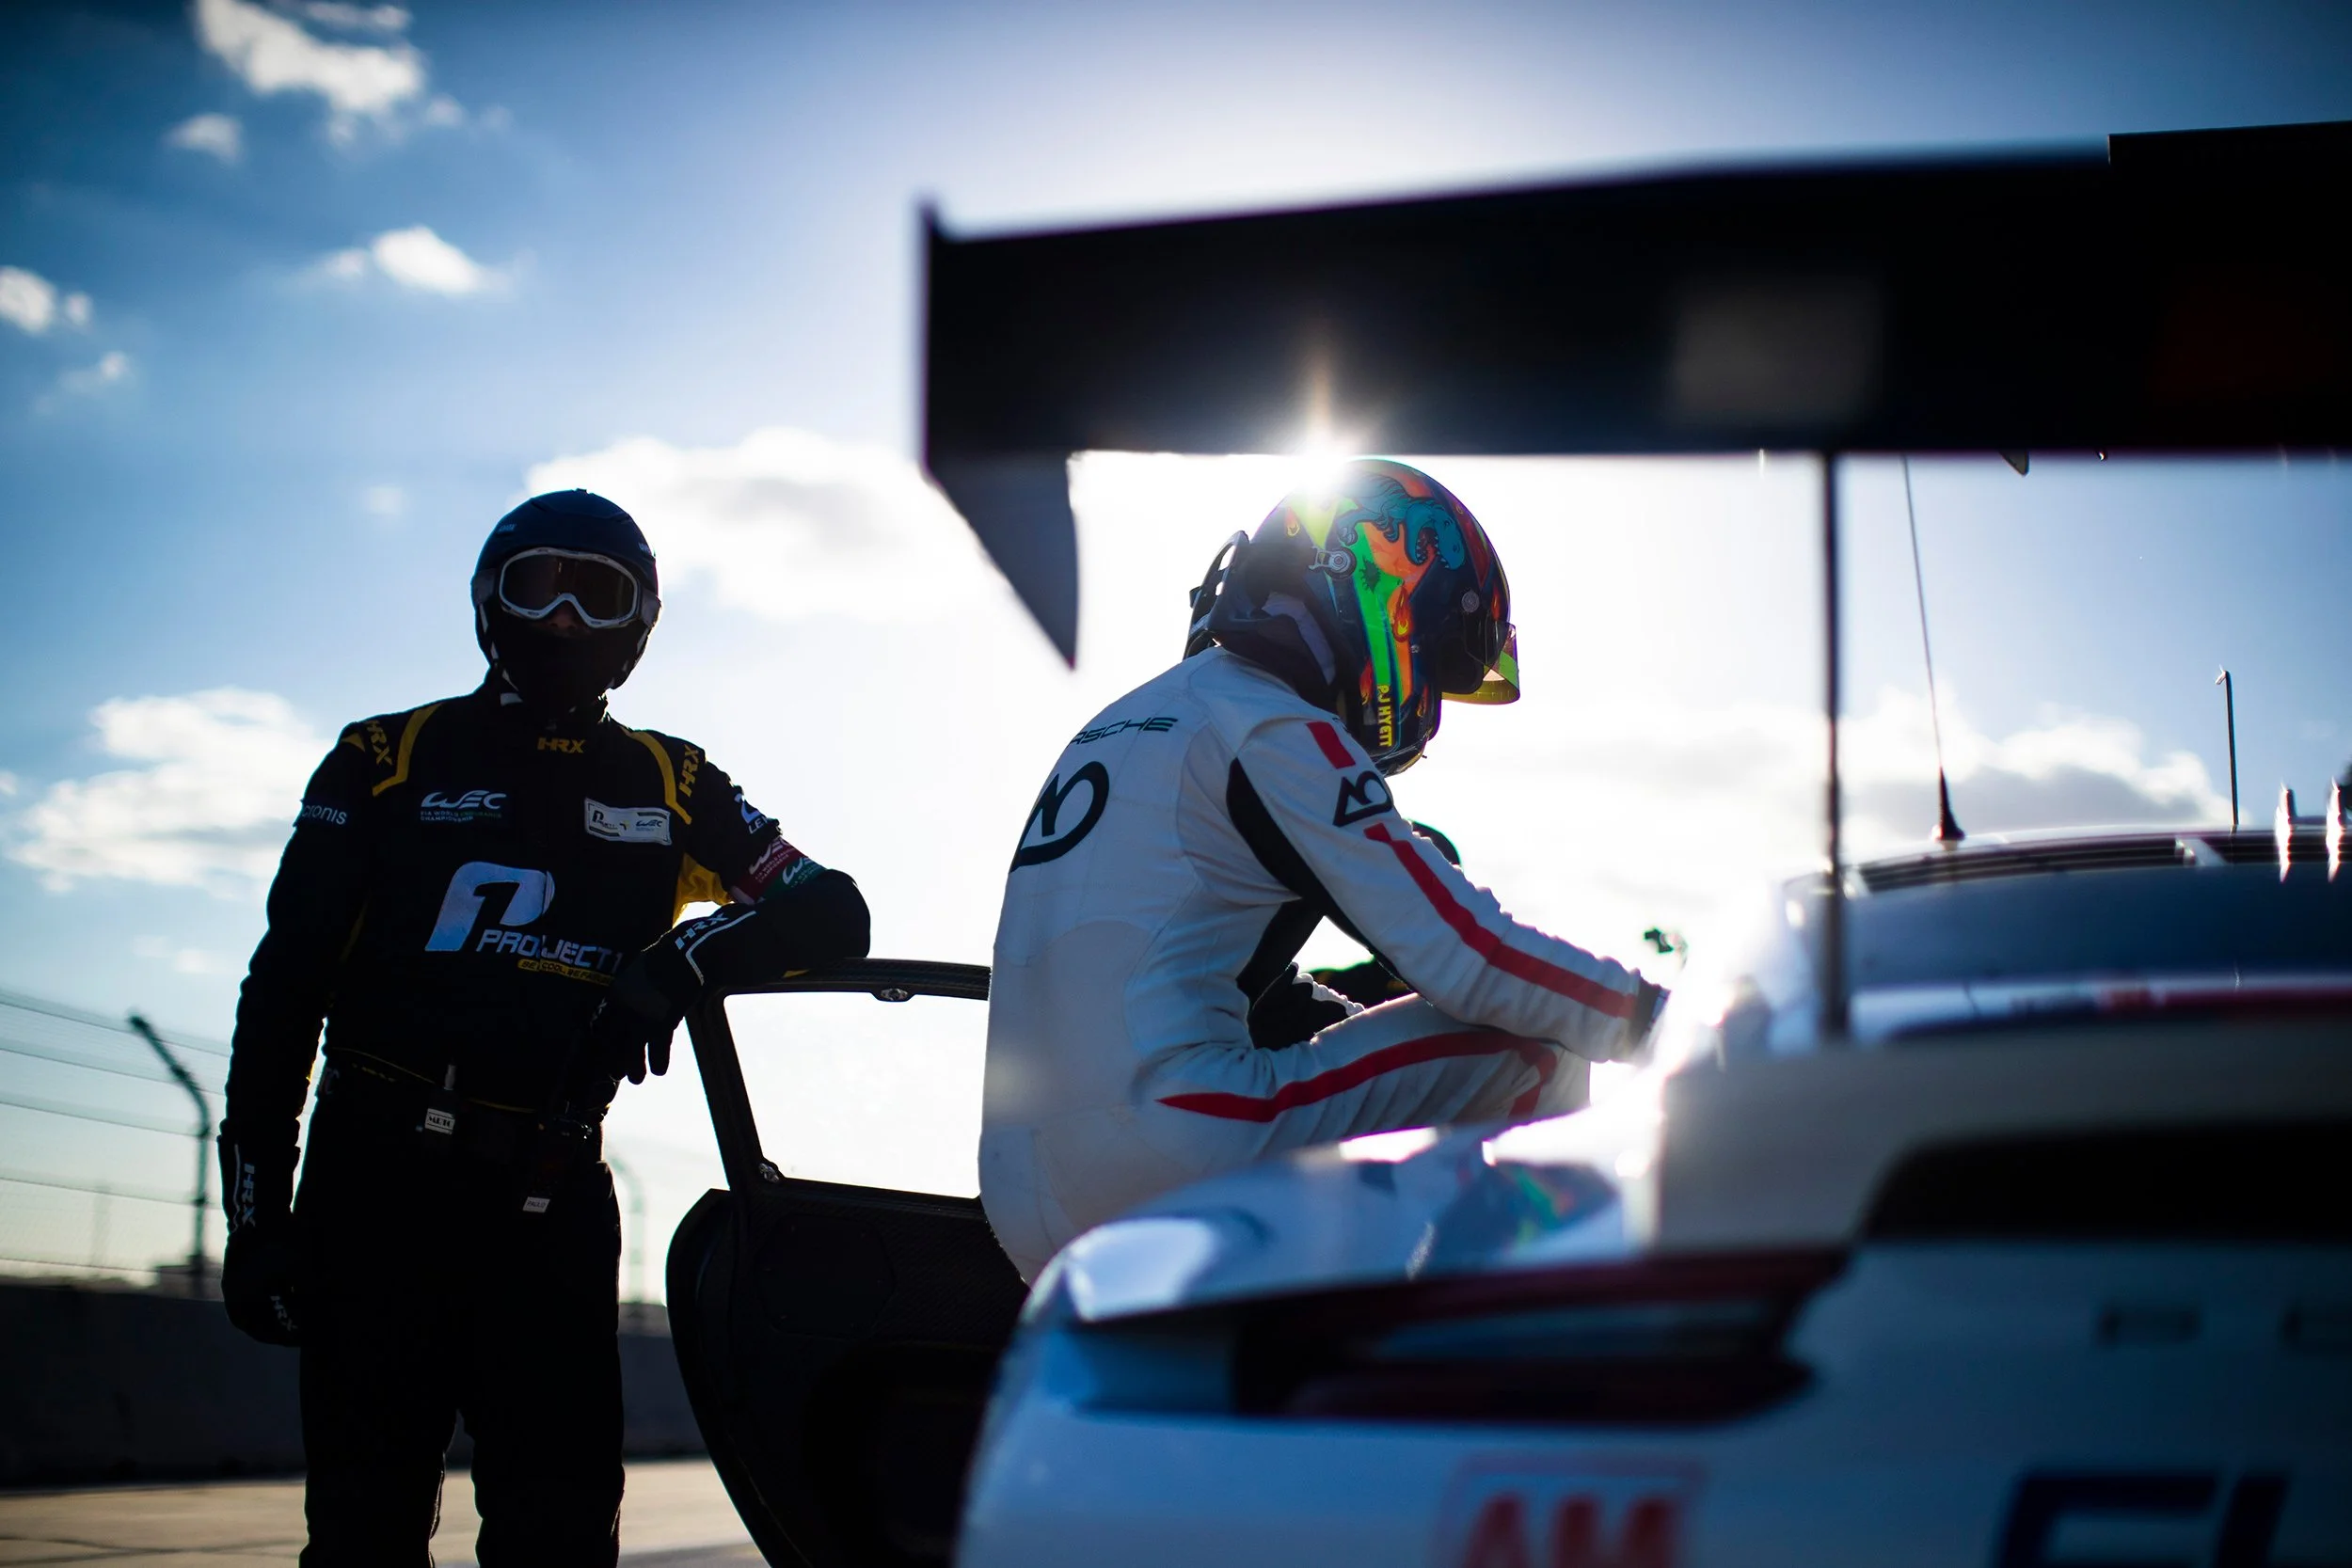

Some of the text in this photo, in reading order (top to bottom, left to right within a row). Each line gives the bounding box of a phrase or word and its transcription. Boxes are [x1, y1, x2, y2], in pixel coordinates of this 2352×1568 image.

[364, 720, 393, 766] HRX
[537, 736, 586, 753] HRX
[1068, 717, 1178, 745] RSCHE
[678, 744, 700, 798] HRX
[301, 803, 348, 826] cronis
[421, 789, 507, 810] WEC
[675, 912, 730, 950] HRX
[242, 1163, 257, 1227] HRX
